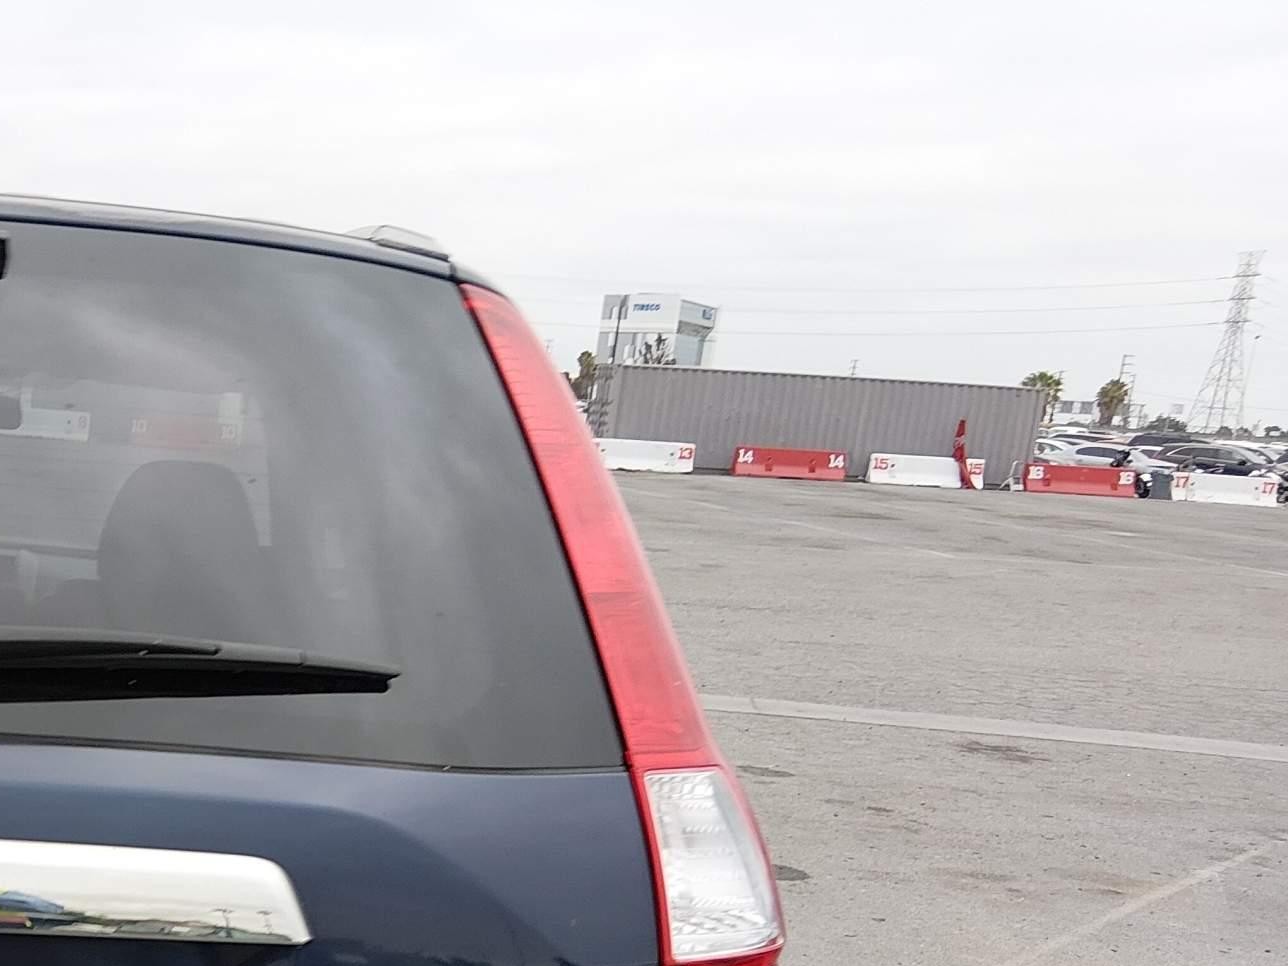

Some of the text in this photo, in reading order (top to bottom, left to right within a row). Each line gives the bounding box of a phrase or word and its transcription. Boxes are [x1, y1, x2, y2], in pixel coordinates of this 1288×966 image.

[736, 448, 754, 464] 14
[828, 453, 845, 469] 14
[872, 457, 889, 470] 15
[969, 463, 983, 475] 15
[1174, 476, 1190, 489] 17
[1261, 481, 1277, 495] 17
